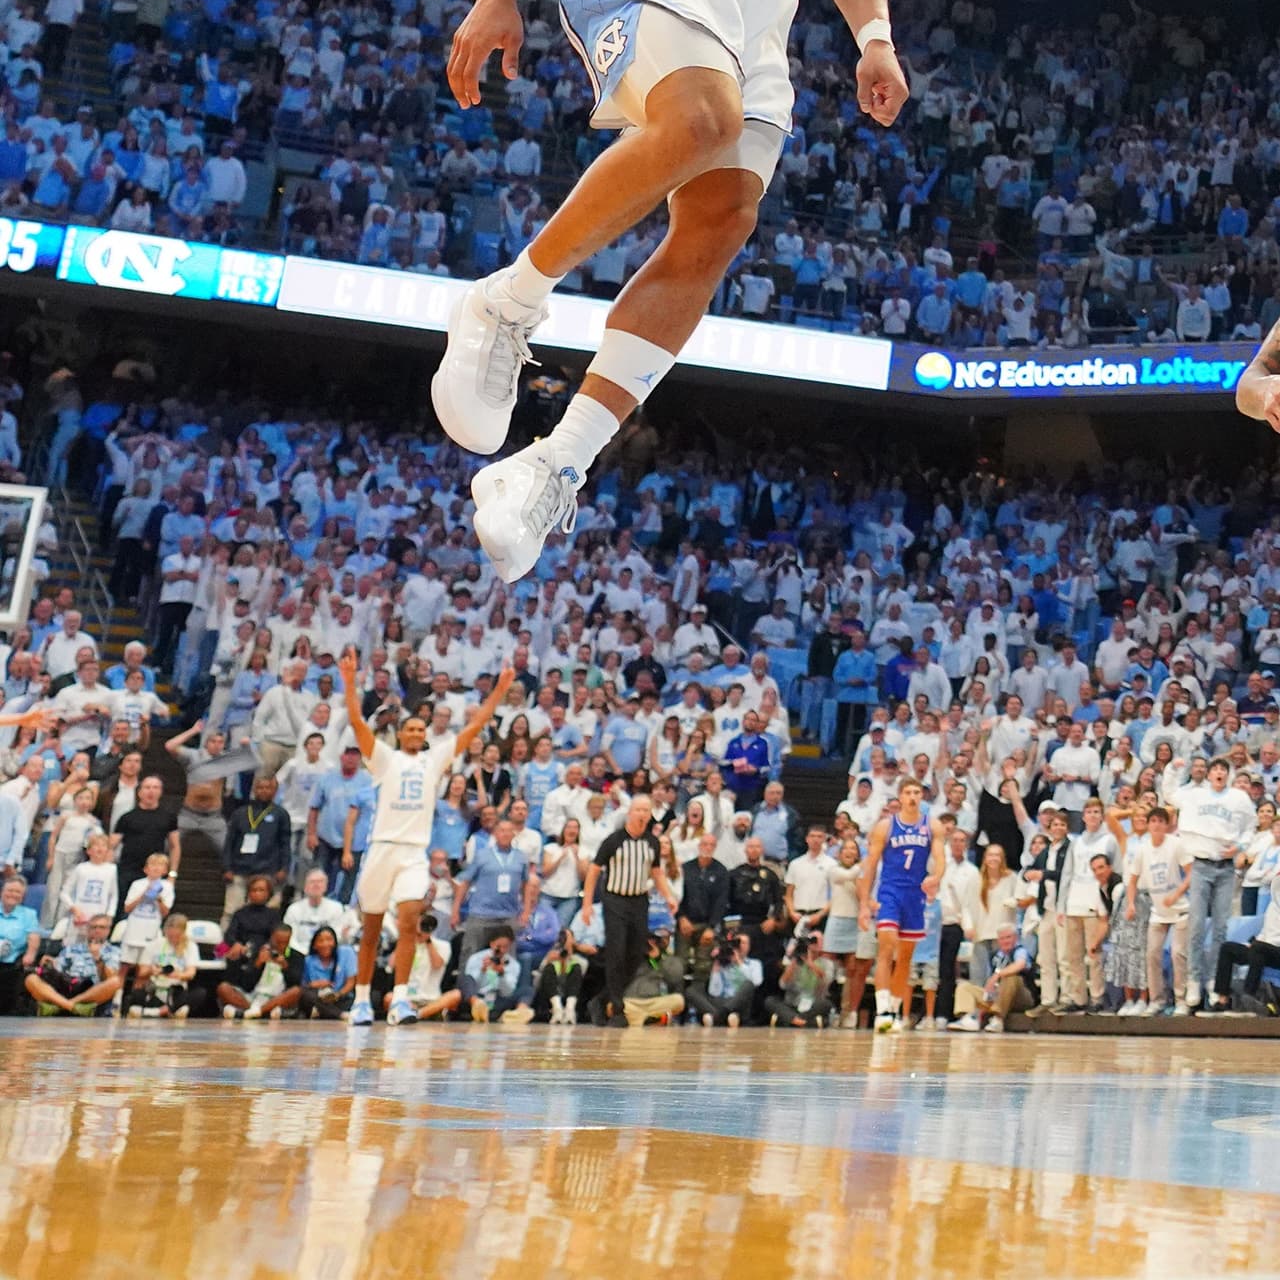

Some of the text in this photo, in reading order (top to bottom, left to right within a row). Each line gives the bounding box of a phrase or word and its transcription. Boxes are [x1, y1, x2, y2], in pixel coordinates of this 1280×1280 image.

[219, 273, 277, 303] FLS: 7
[954, 357, 1245, 389] NC Education Lottery
[400, 781, 424, 800] 15
[890, 834, 929, 848] KANSAS
[903, 849, 915, 870] 7
